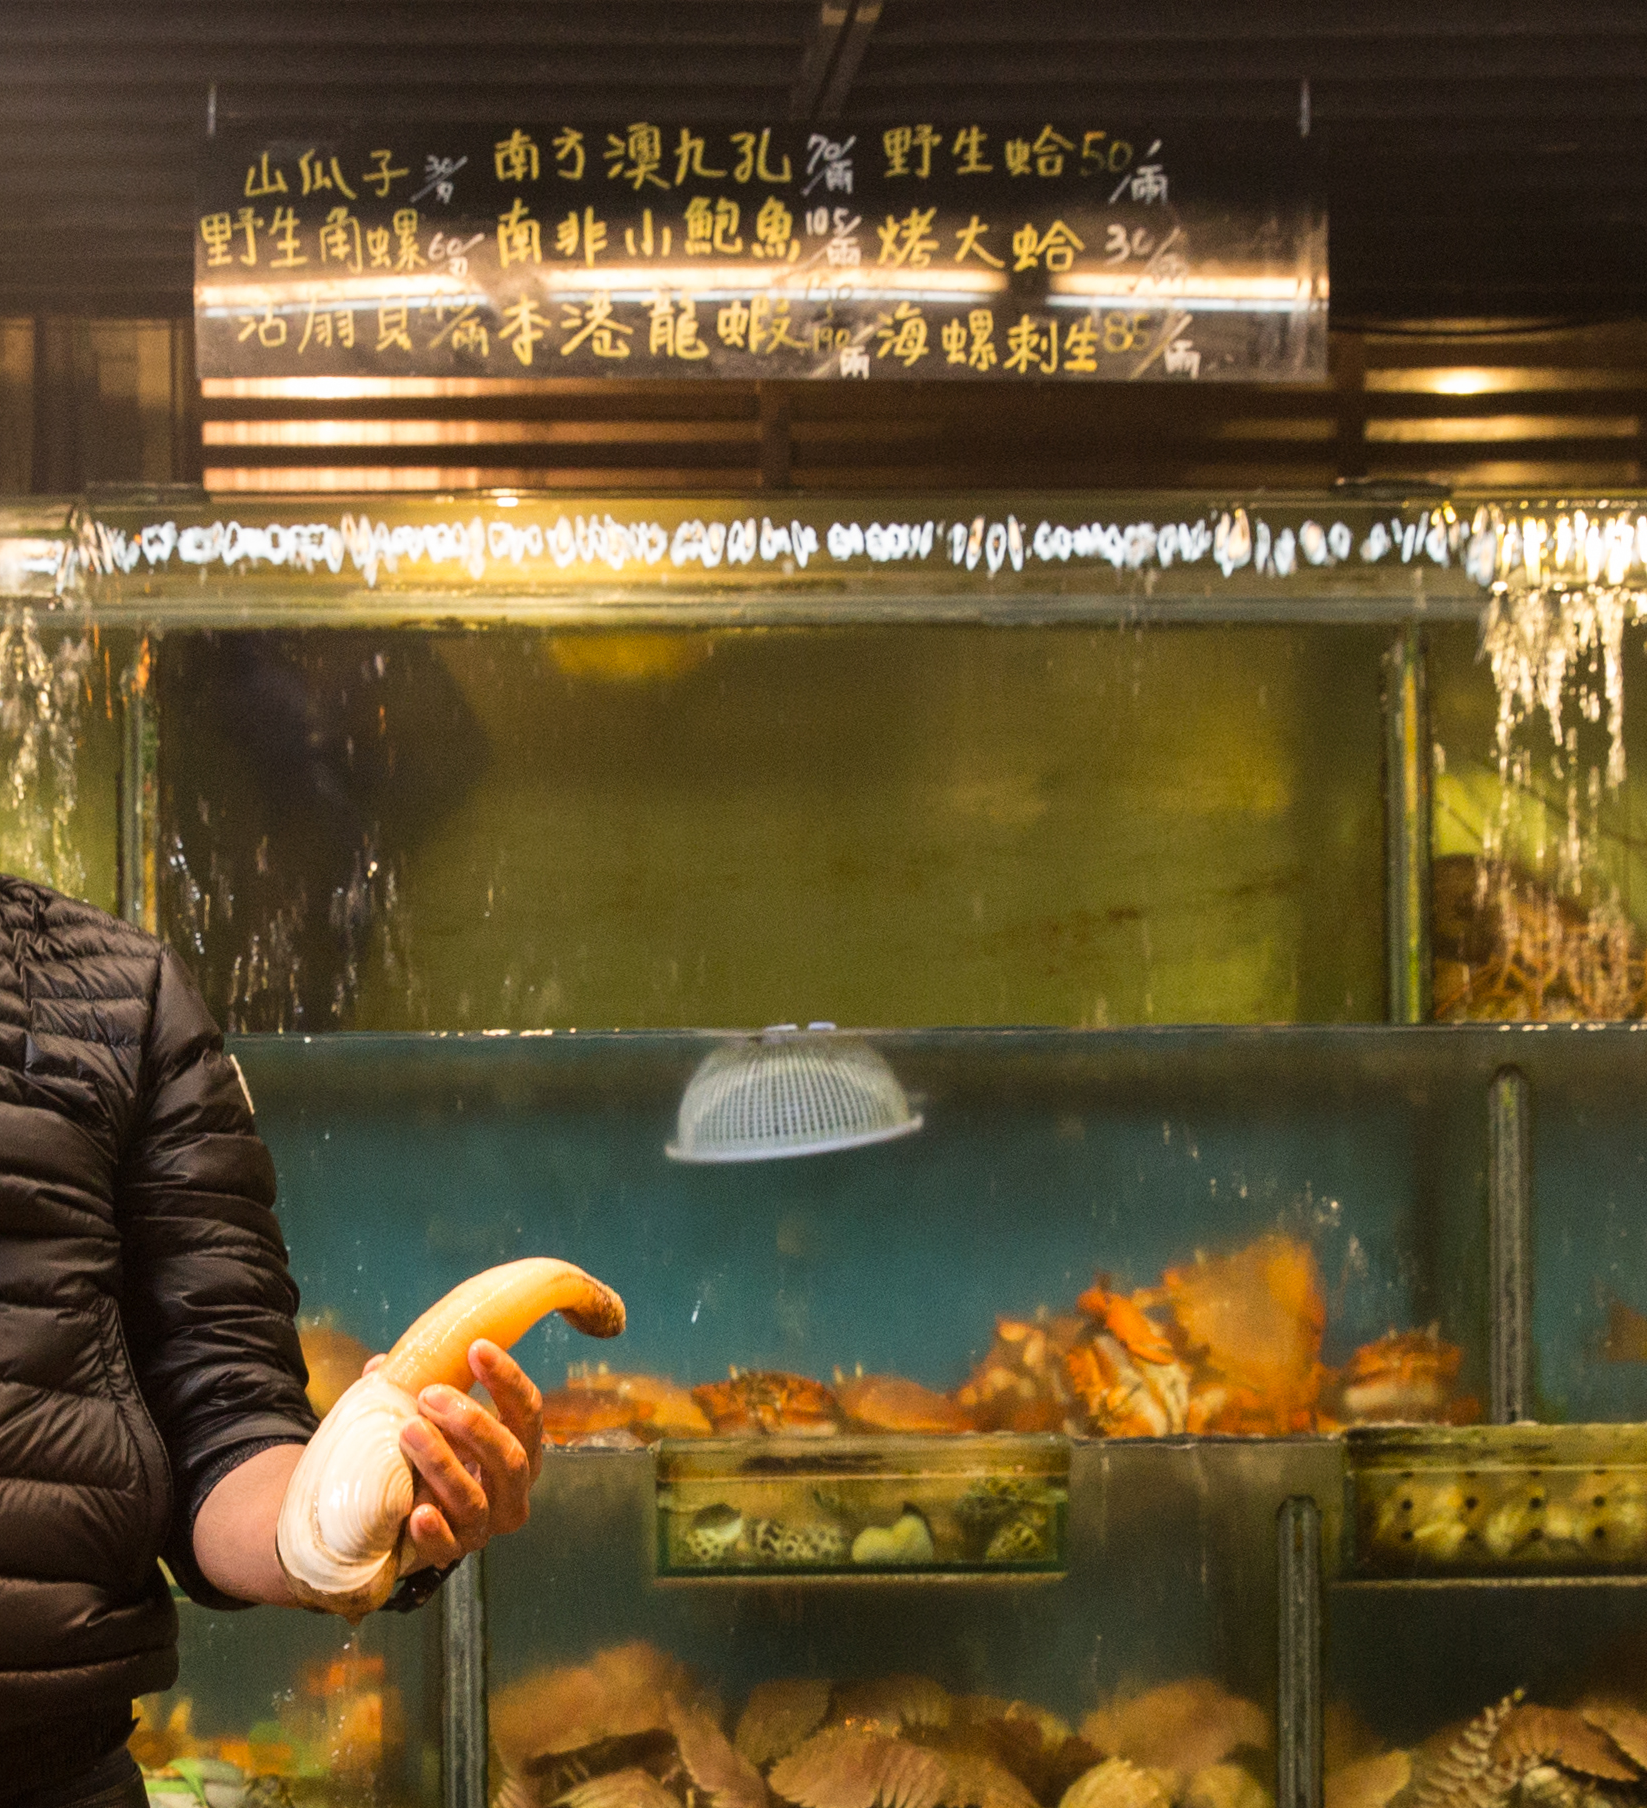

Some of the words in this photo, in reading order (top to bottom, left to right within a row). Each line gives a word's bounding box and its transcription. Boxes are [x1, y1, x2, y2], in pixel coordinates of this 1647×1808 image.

[883, 124, 1076, 178] 野生蛤
[498, 195, 800, 268] 南非小鮑魚
